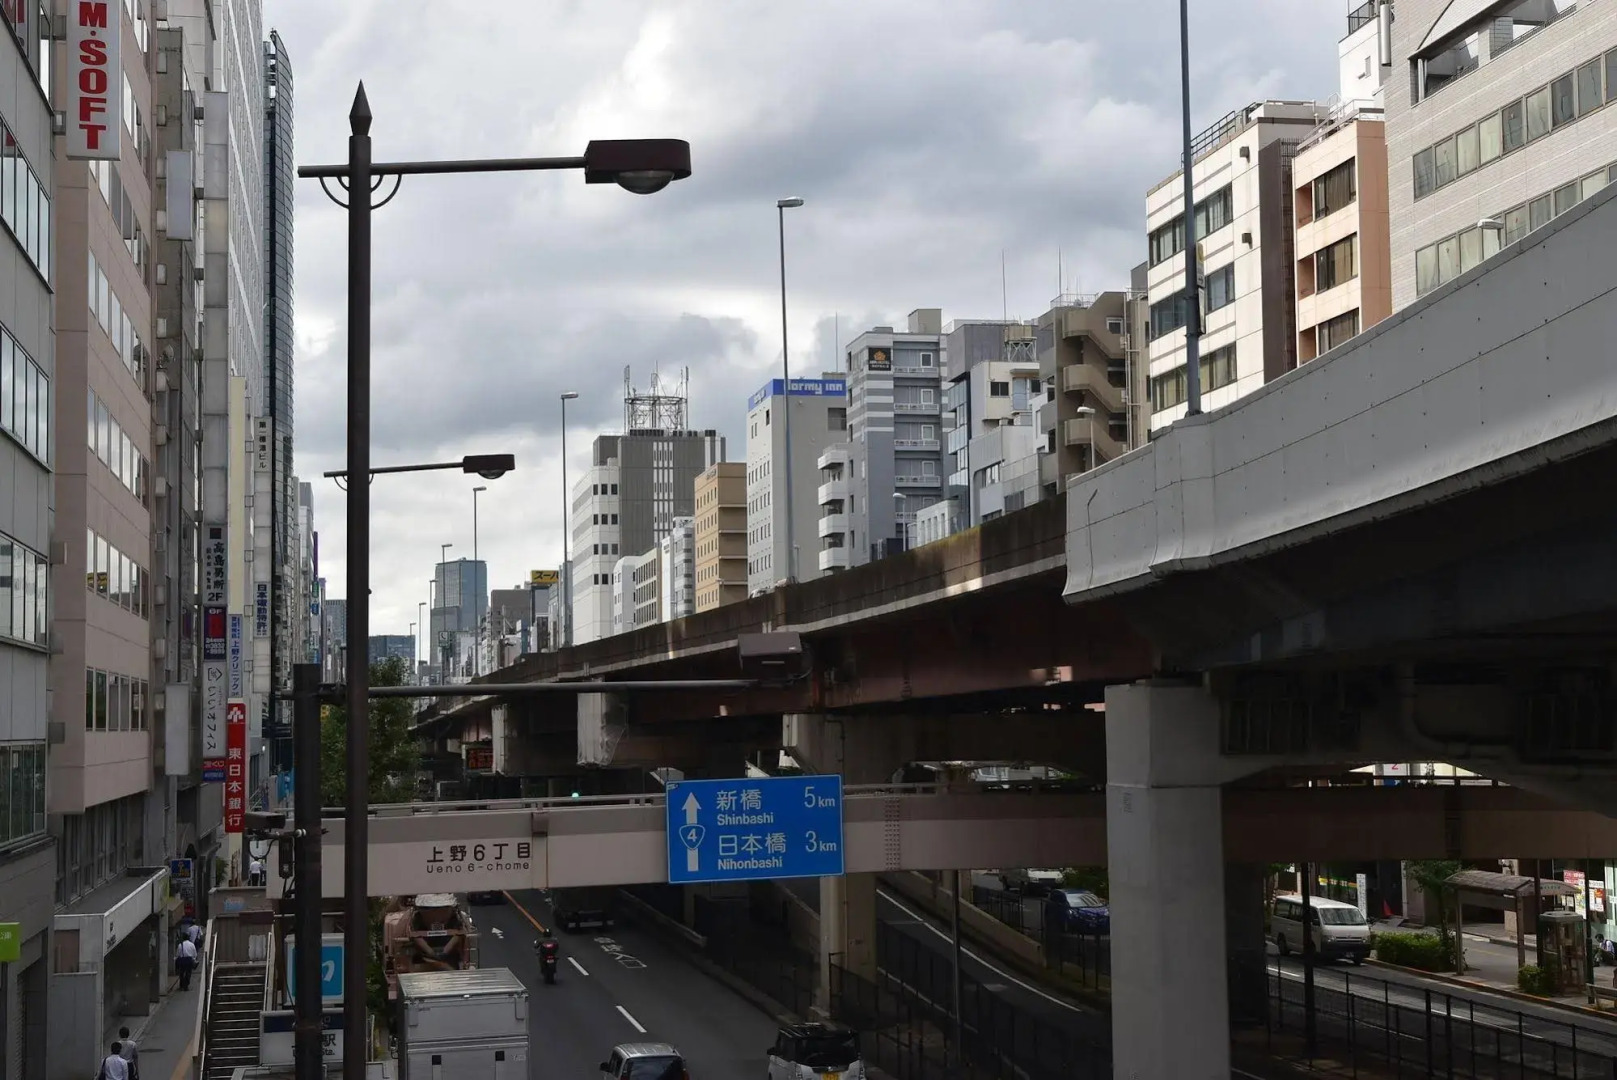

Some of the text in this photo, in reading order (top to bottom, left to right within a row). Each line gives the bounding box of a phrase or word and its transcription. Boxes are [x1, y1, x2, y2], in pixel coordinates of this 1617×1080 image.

[825, 383, 843, 392] inn
[208, 592, 223, 602] 2F
[207, 685, 217, 750] いいオフィス
[227, 748, 242, 826] 東日本銀行
[716, 788, 763, 811] 新橋
[717, 811, 774, 826] Shinbashi
[687, 828, 698, 842] 4
[718, 831, 787, 856] 日本橋
[426, 842, 531, 863] 上野6丁目
[426, 864, 462, 874] Ueno
[717, 856, 784, 871] Nihonbashi
